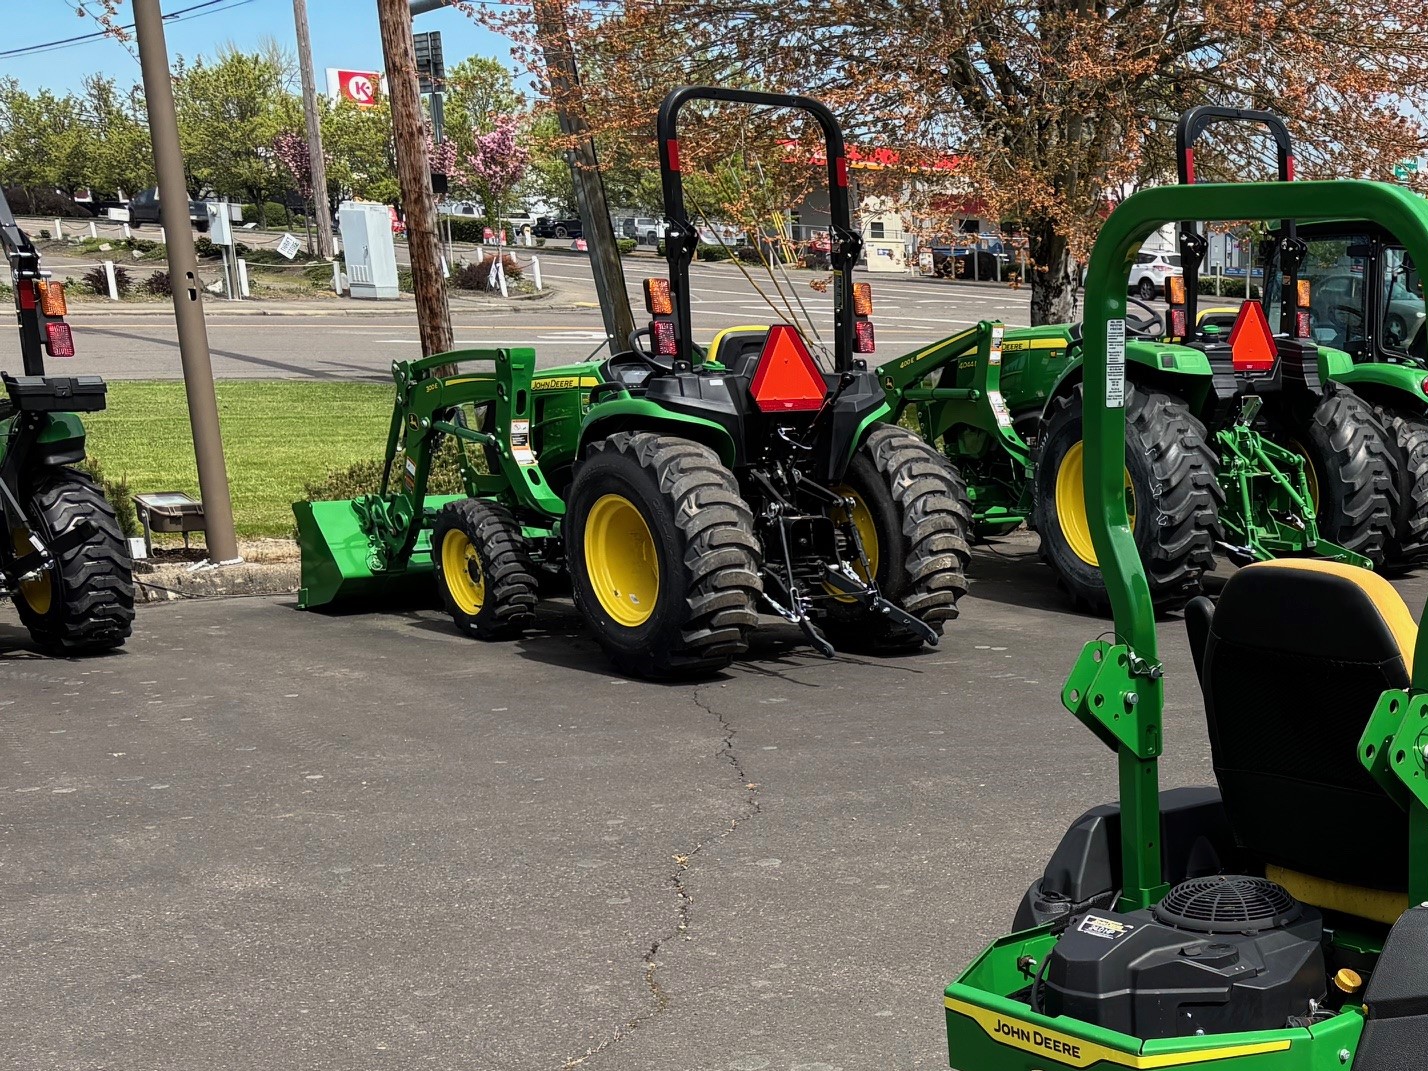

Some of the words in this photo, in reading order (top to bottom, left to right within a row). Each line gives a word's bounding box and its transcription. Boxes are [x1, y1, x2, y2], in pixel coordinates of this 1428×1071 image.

[1002, 343, 1023, 351] DEERE
[900, 358, 914, 368] 400E
[426, 382, 438, 393] 300E
[532, 379, 550, 390] JOHN
[550, 379, 574, 389] DEERE
[994, 1019, 1030, 1042] JOHN
[1033, 1030, 1081, 1059] DEERE
